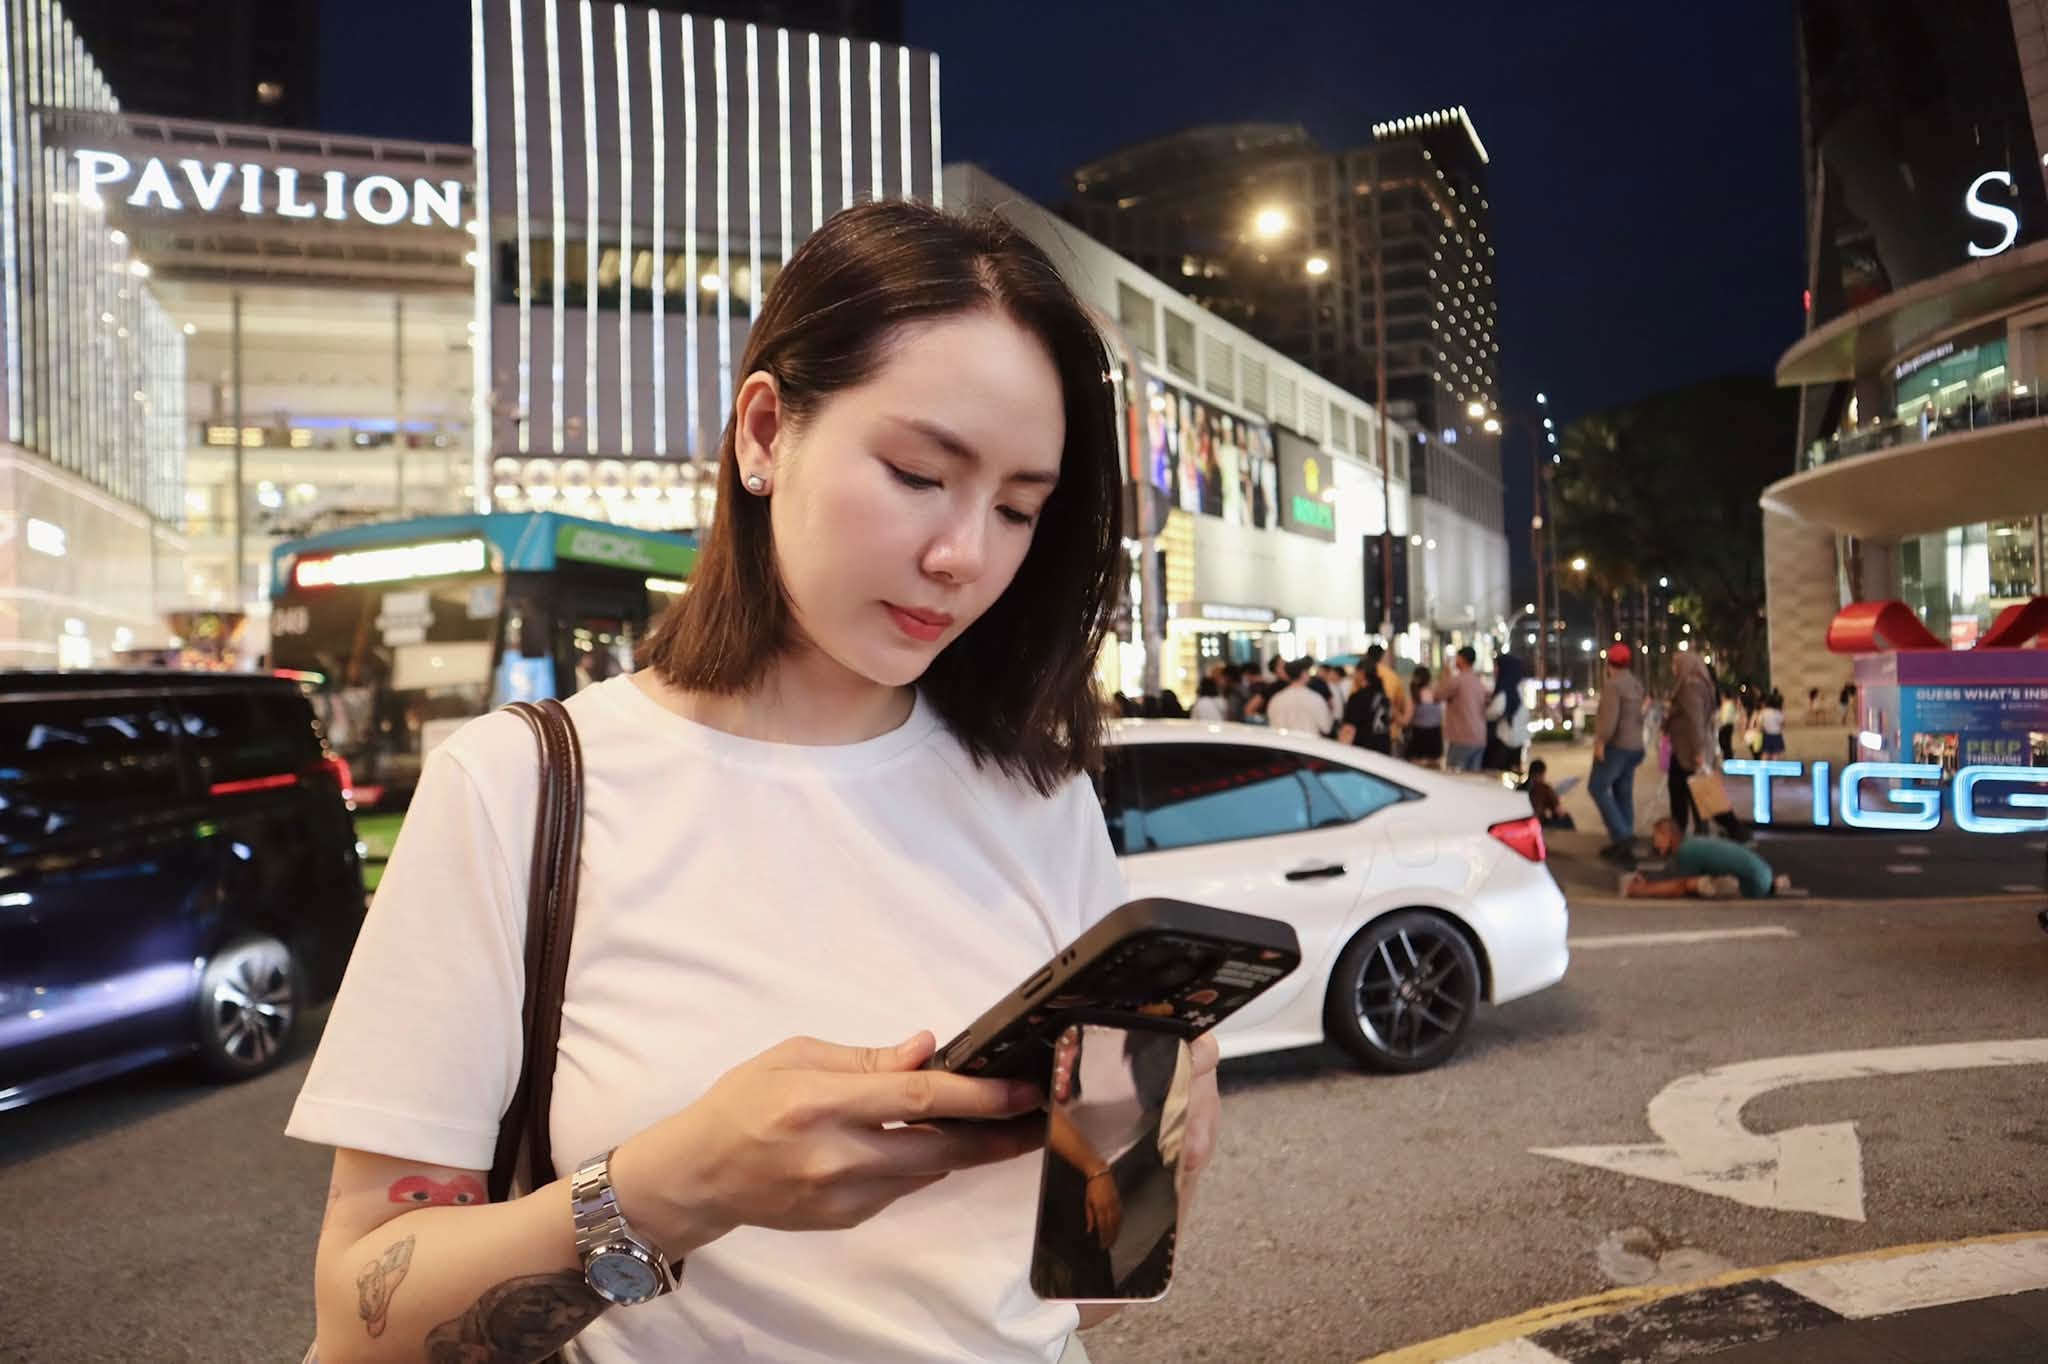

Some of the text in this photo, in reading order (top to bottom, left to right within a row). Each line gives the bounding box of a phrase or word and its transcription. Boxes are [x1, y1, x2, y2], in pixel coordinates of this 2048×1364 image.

[73, 149, 462, 228] PAVILION
[1966, 170, 2018, 257] S
[1916, 687, 1960, 701] GUESS
[1964, 687, 2021, 701] WHAT'S
[1966, 740, 2021, 756] PEEP
[1722, 759, 2048, 834] TIGG
